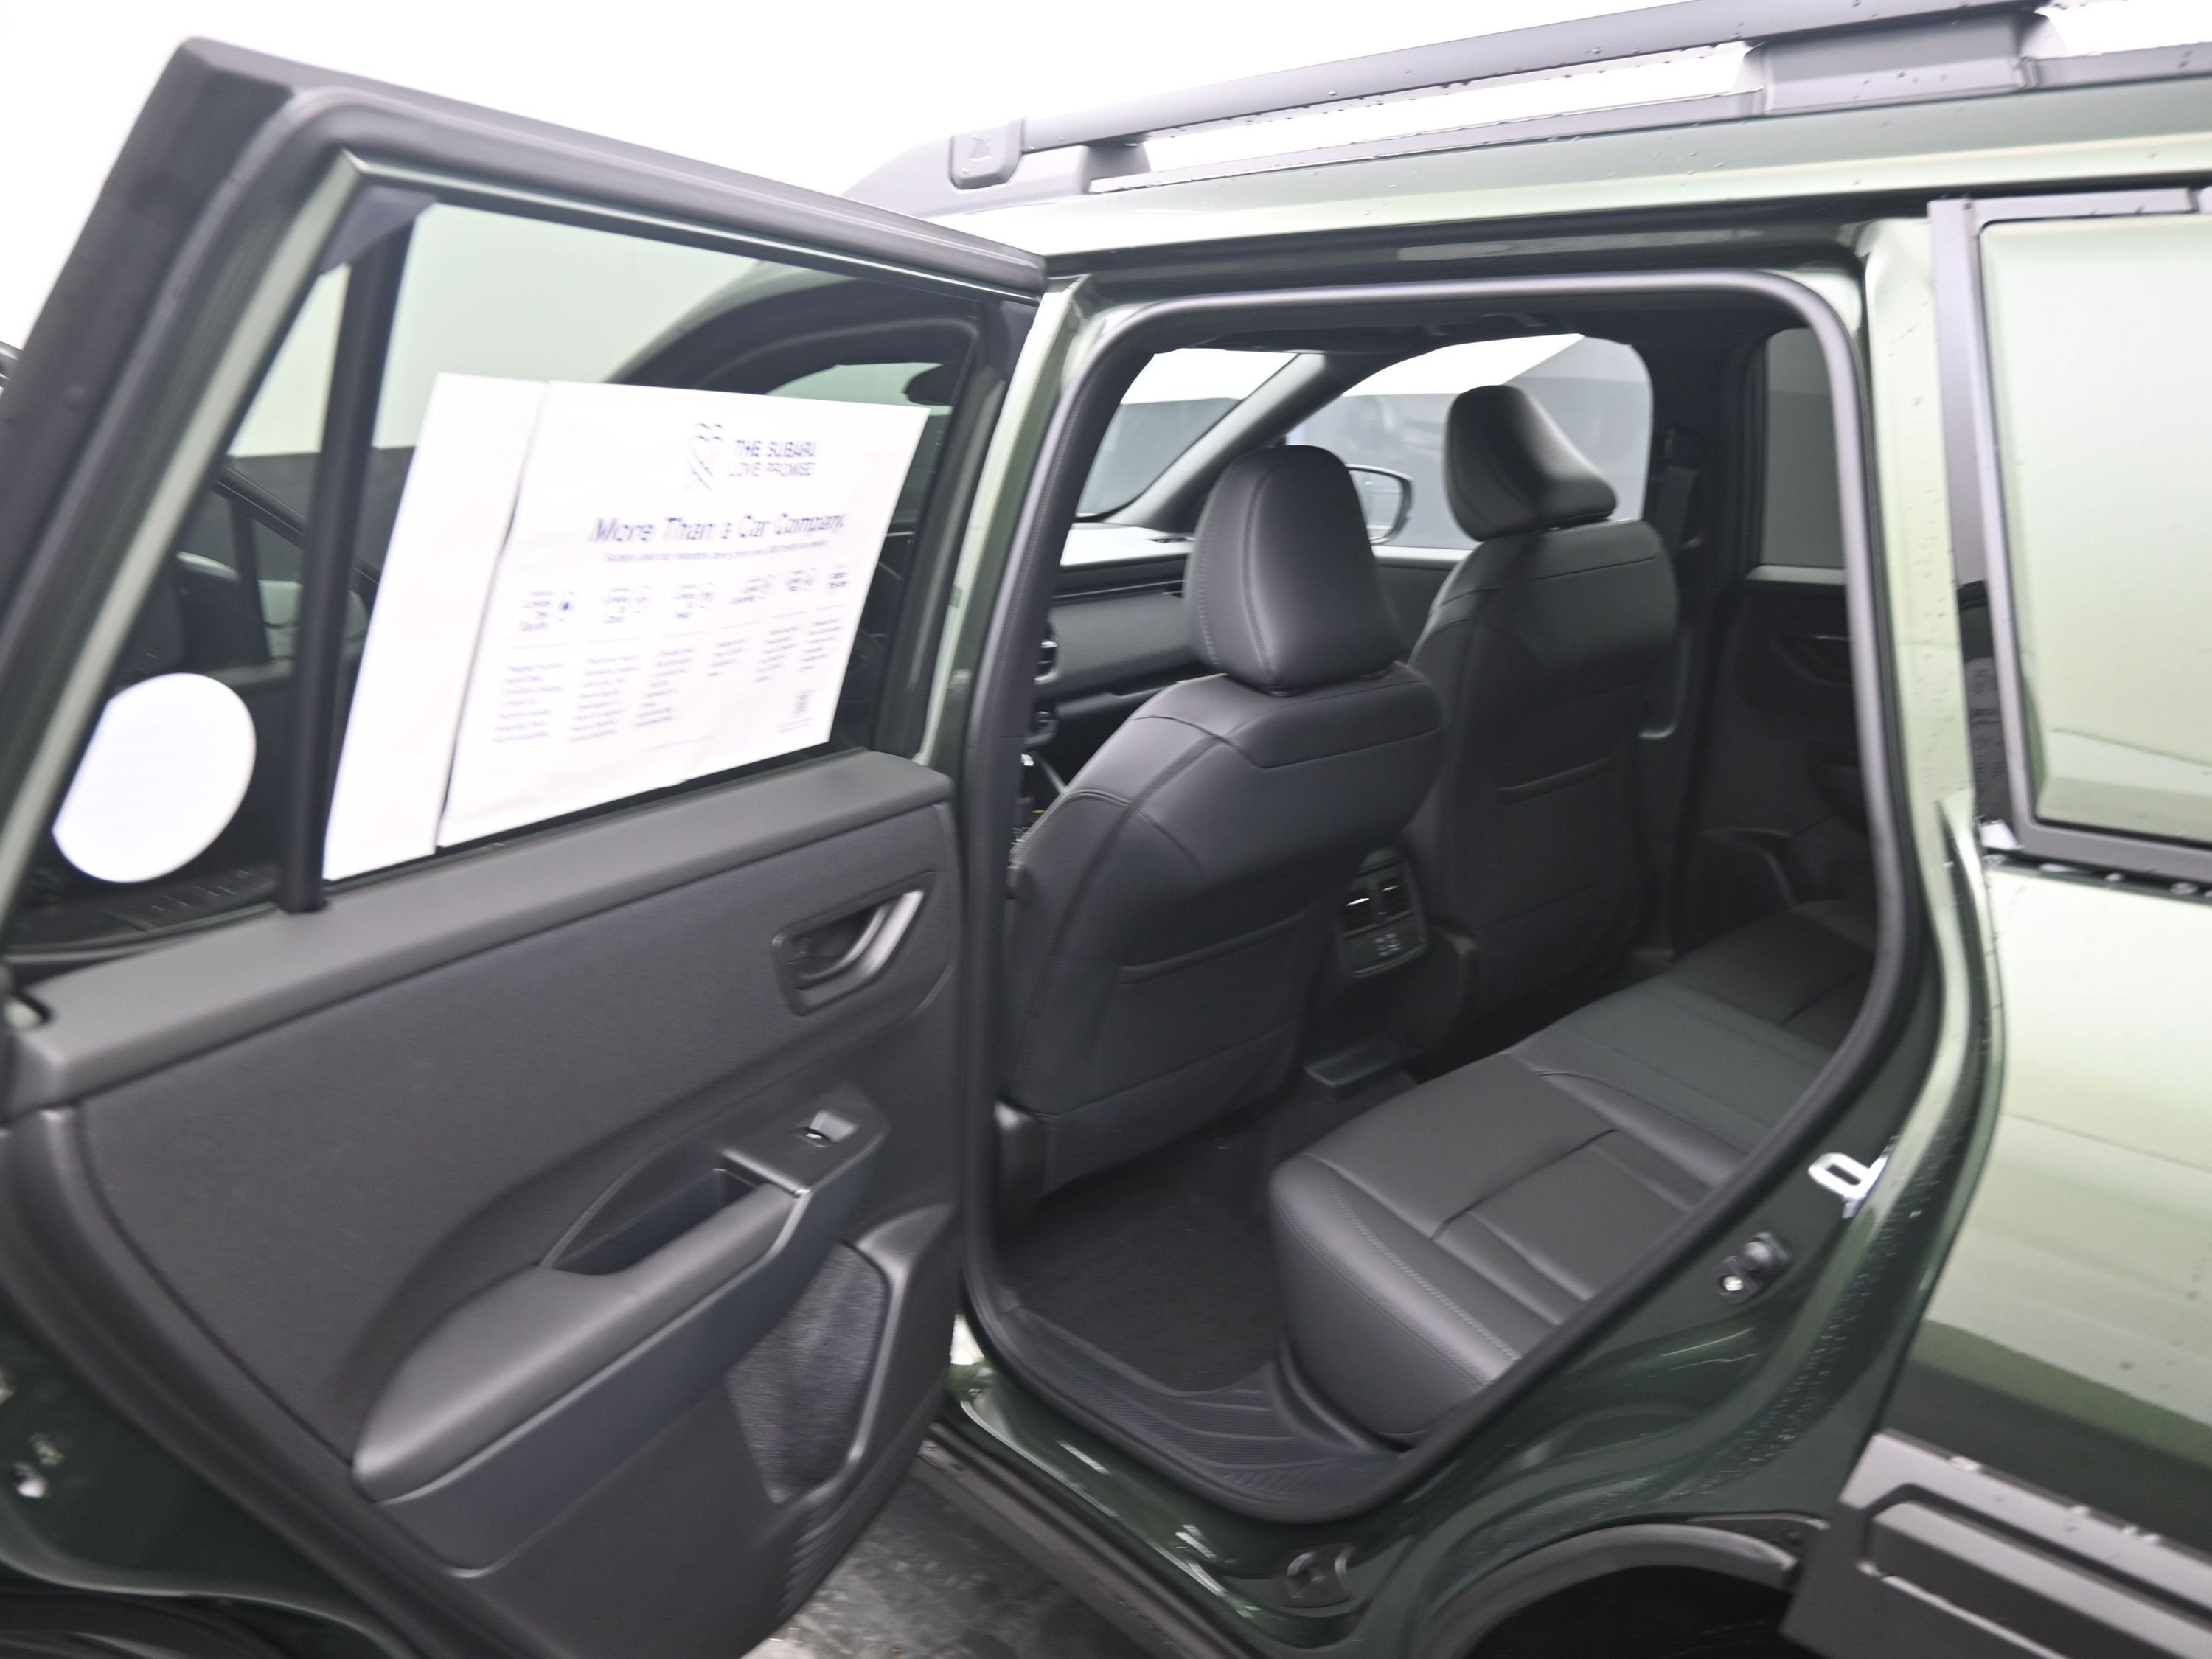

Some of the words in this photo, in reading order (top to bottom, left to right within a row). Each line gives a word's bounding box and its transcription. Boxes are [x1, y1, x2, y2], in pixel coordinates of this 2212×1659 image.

[734, 439, 762, 458] THE
[590, 518, 655, 542] More
[664, 517, 715, 540] Than
[720, 522, 734, 540] a
[737, 514, 770, 538] Car
